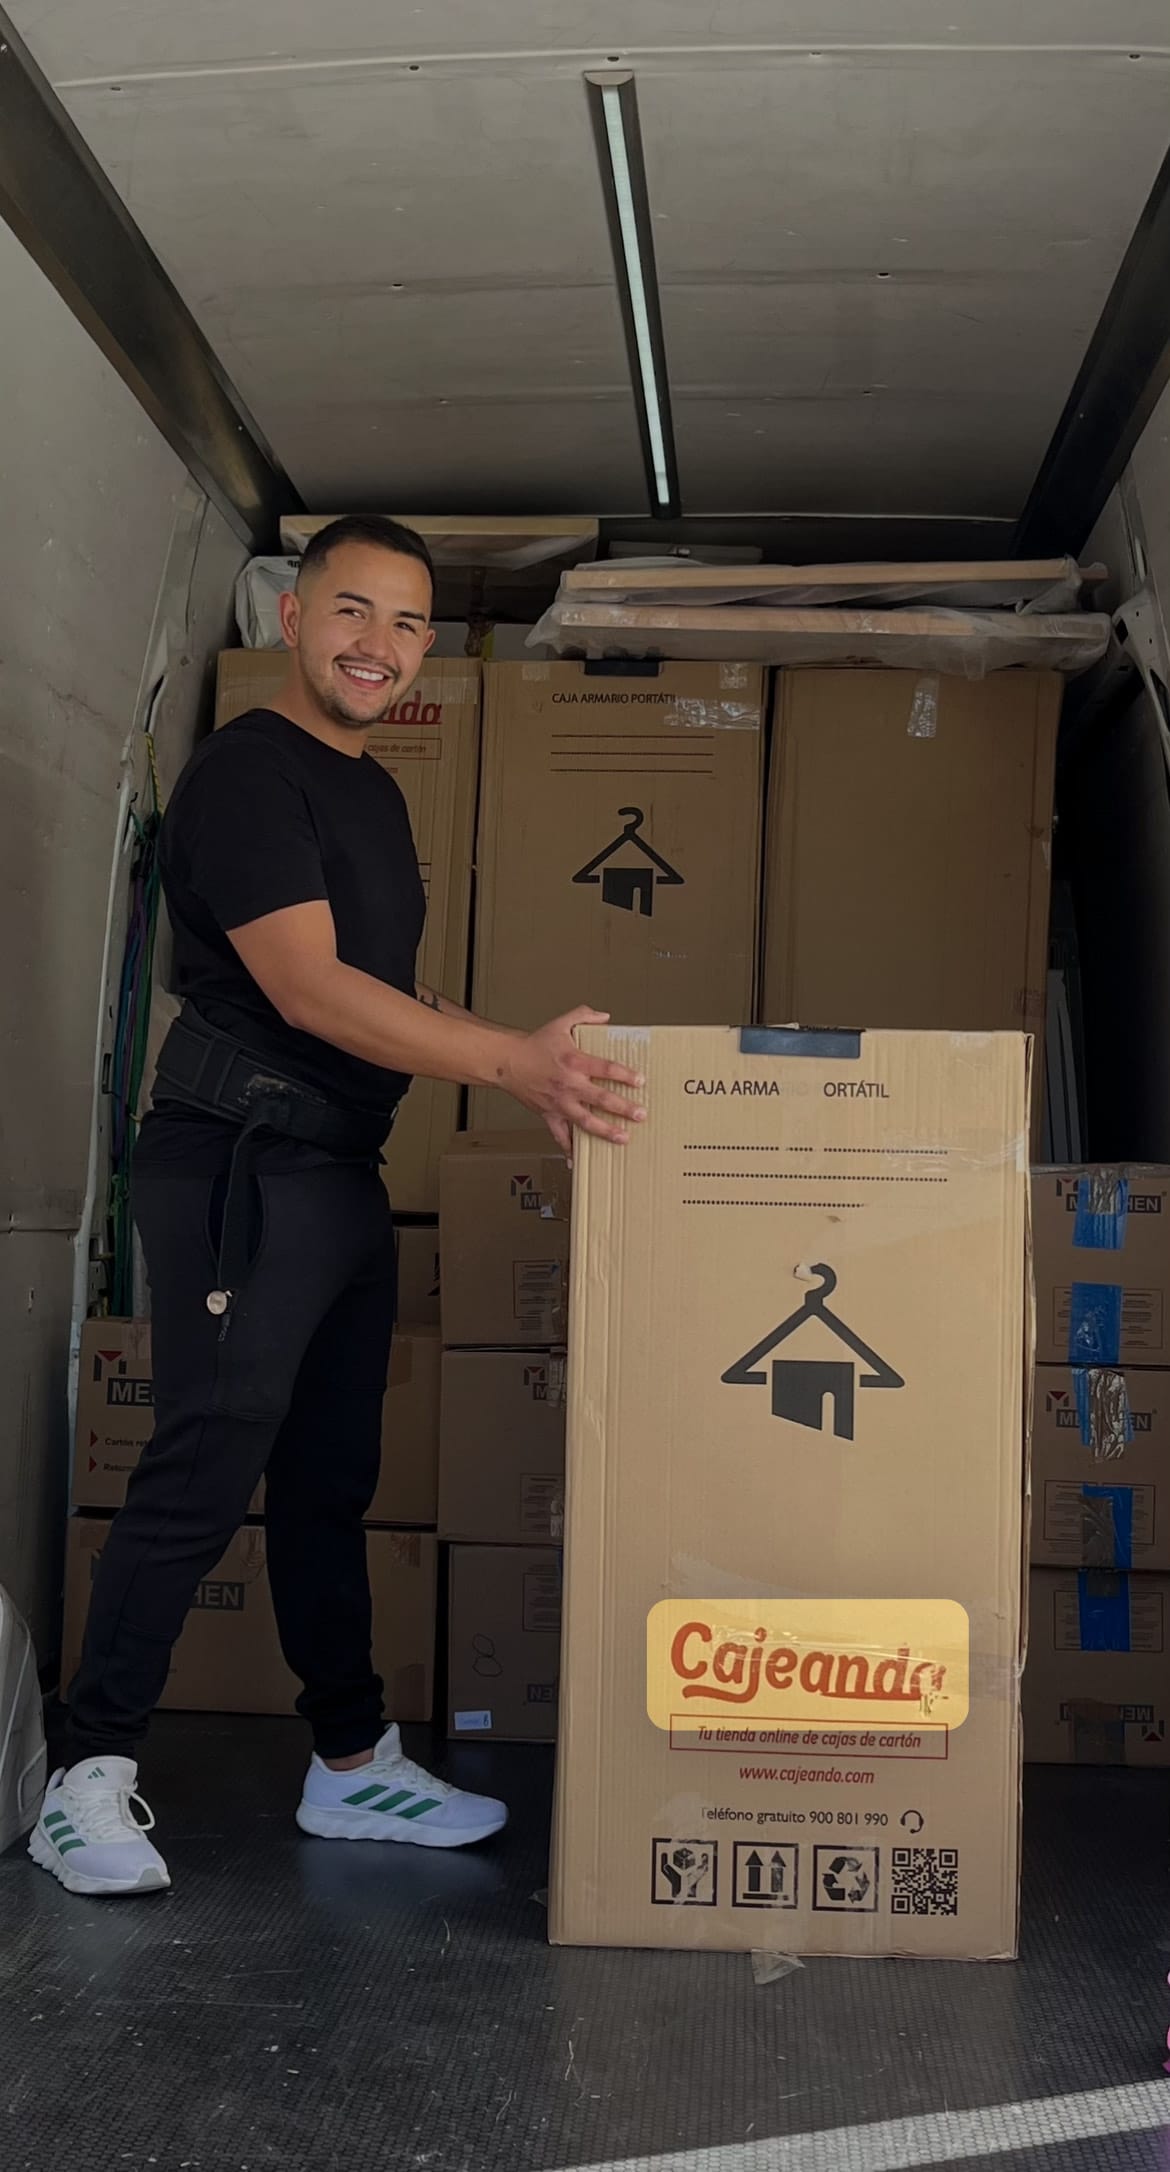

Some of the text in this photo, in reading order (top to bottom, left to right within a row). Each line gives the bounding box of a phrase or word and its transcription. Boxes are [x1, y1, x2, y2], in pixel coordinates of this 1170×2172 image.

[551, 693, 578, 704] CAJA
[580, 693, 629, 704] ARMARIO
[683, 1079, 890, 1099] CAJA ARMA ORTÁTIL
[670, 1621, 948, 1704] Cajeando
[697, 1725, 922, 1750] Tu tienda online de cajas de cartón
[739, 1765, 876, 1784] www.cajeando.com
[756, 1809, 806, 1825] gratuito
[808, 1810, 833, 1824] 900
[836, 1812, 859, 1825] 801
[863, 1813, 889, 1826] 990
